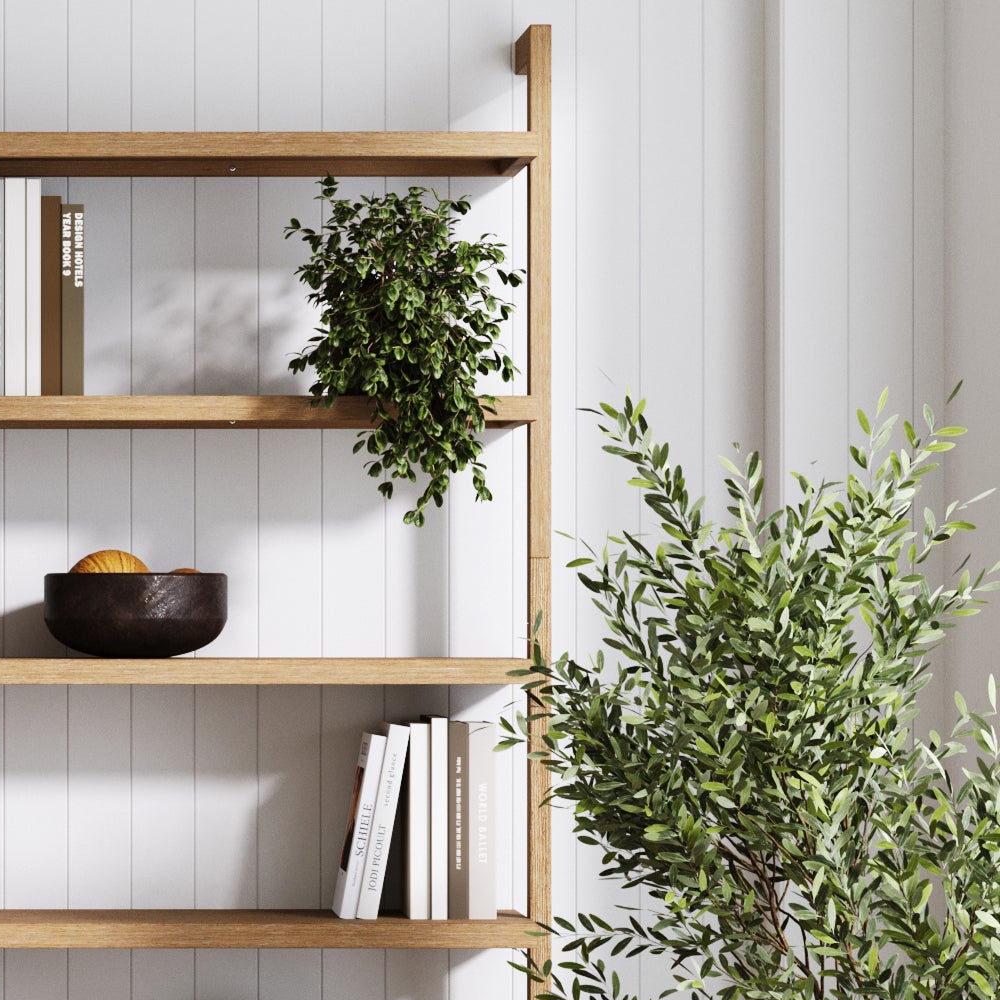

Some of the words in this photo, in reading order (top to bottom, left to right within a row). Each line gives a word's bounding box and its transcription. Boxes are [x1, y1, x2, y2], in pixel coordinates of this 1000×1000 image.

[62, 212, 71, 238] YEAR
[74, 212, 84, 249] DESIGN
[62, 240, 71, 267] BOOK
[74, 251, 84, 288] HOTELS
[62, 269, 71, 277] 9
[388, 752, 398, 778] glance
[384, 779, 393, 807] second
[477, 783, 488, 821] WORLD
[355, 803, 373, 857] SCHIELE
[372, 824, 387, 866] PICOULT
[478, 825, 488, 864] BALLET
[367, 867, 380, 892] JODI
